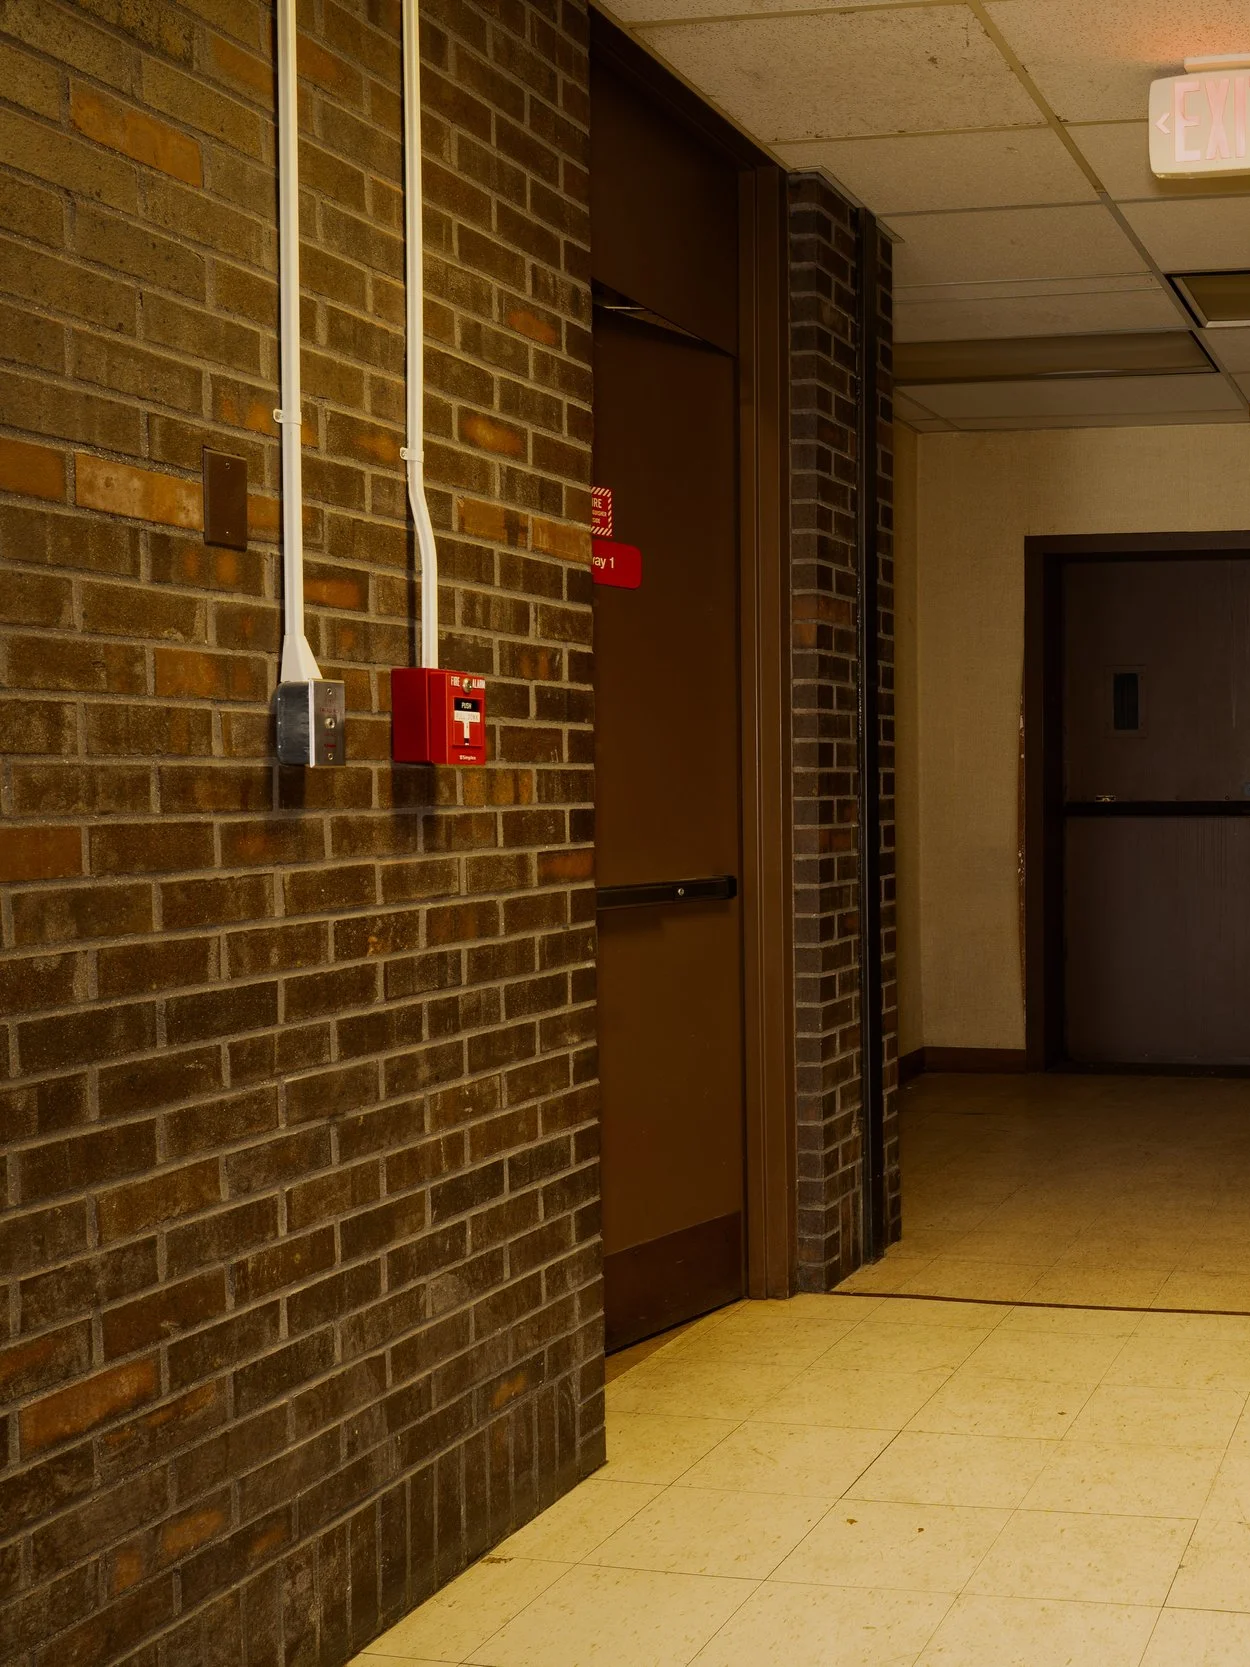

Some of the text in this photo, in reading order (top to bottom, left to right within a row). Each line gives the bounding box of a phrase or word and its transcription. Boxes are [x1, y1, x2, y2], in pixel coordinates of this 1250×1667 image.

[592, 498, 602, 508] IRE
[609, 557, 615, 569] 1
[451, 676, 485, 689] FIRE ALARM
